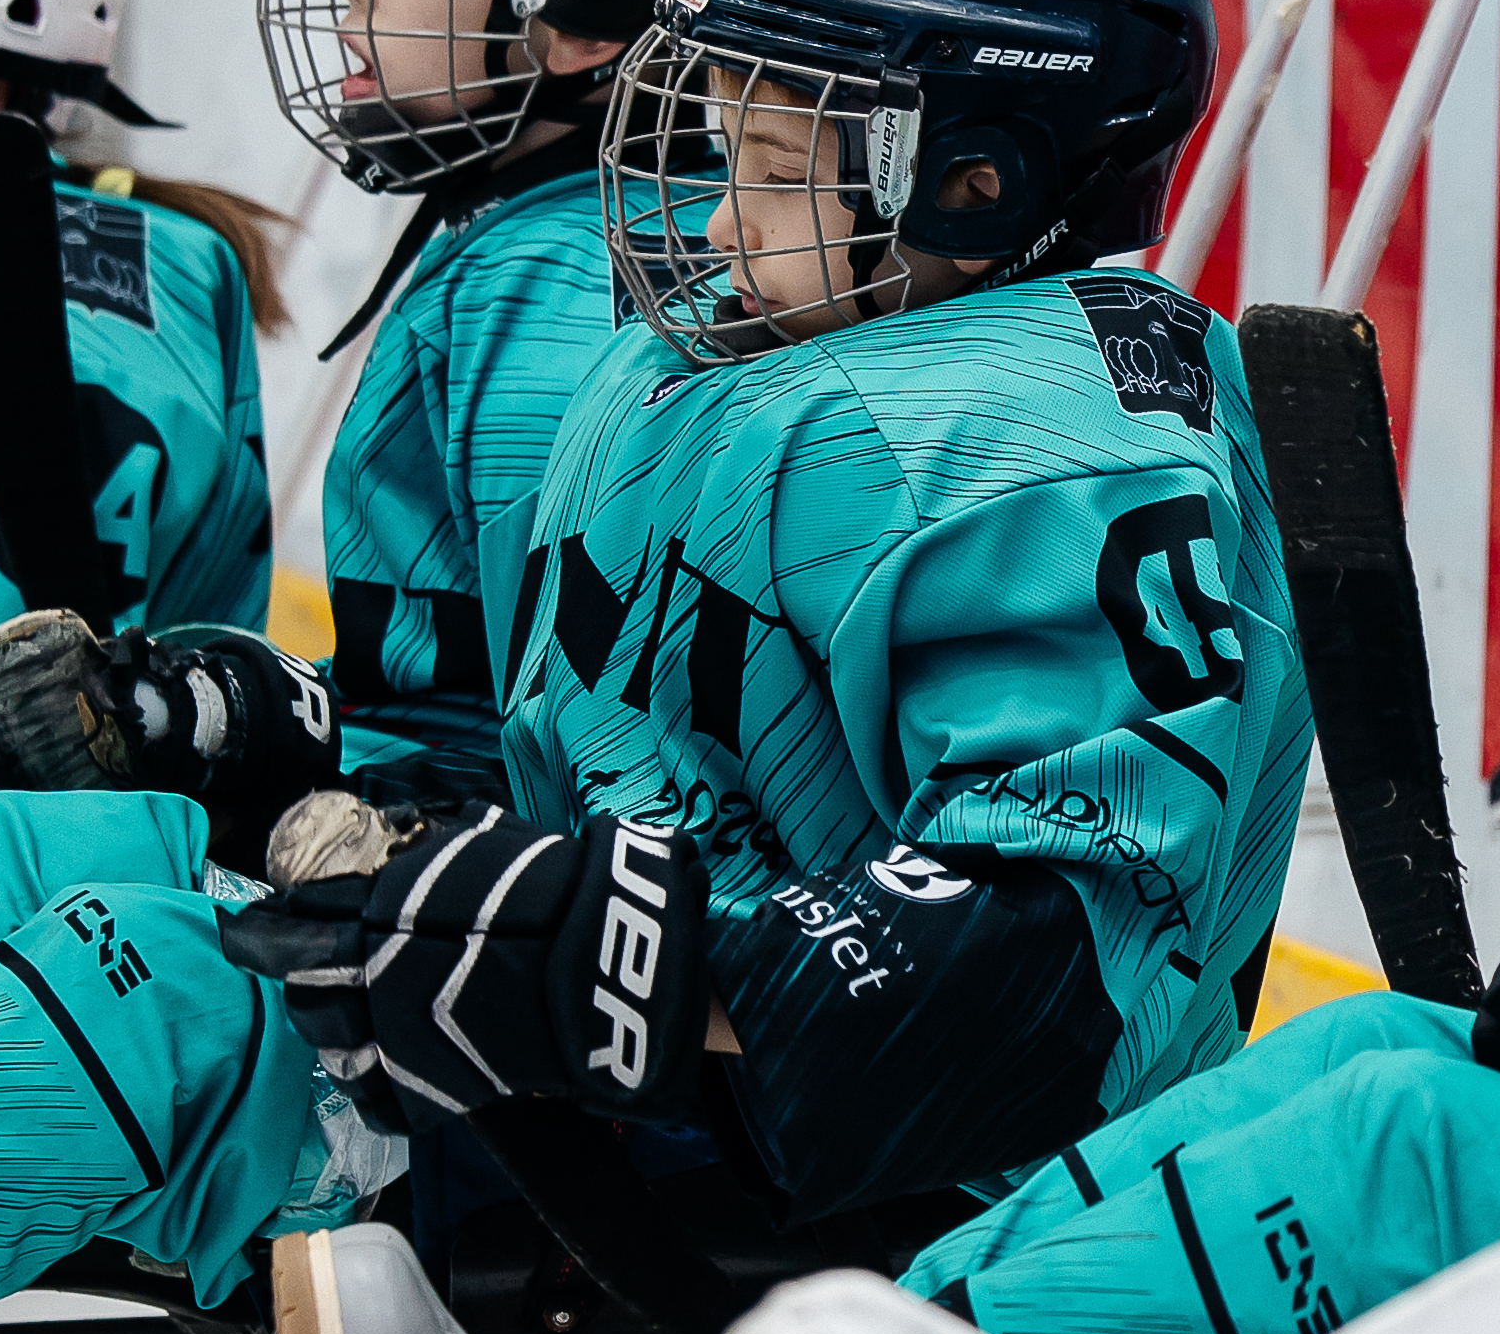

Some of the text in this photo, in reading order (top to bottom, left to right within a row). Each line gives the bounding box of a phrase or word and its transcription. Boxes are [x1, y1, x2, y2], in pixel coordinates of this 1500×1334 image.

[974, 47, 1094, 72] BAUER
[876, 110, 898, 193] BAUER
[771, 883, 890, 998] usJet
